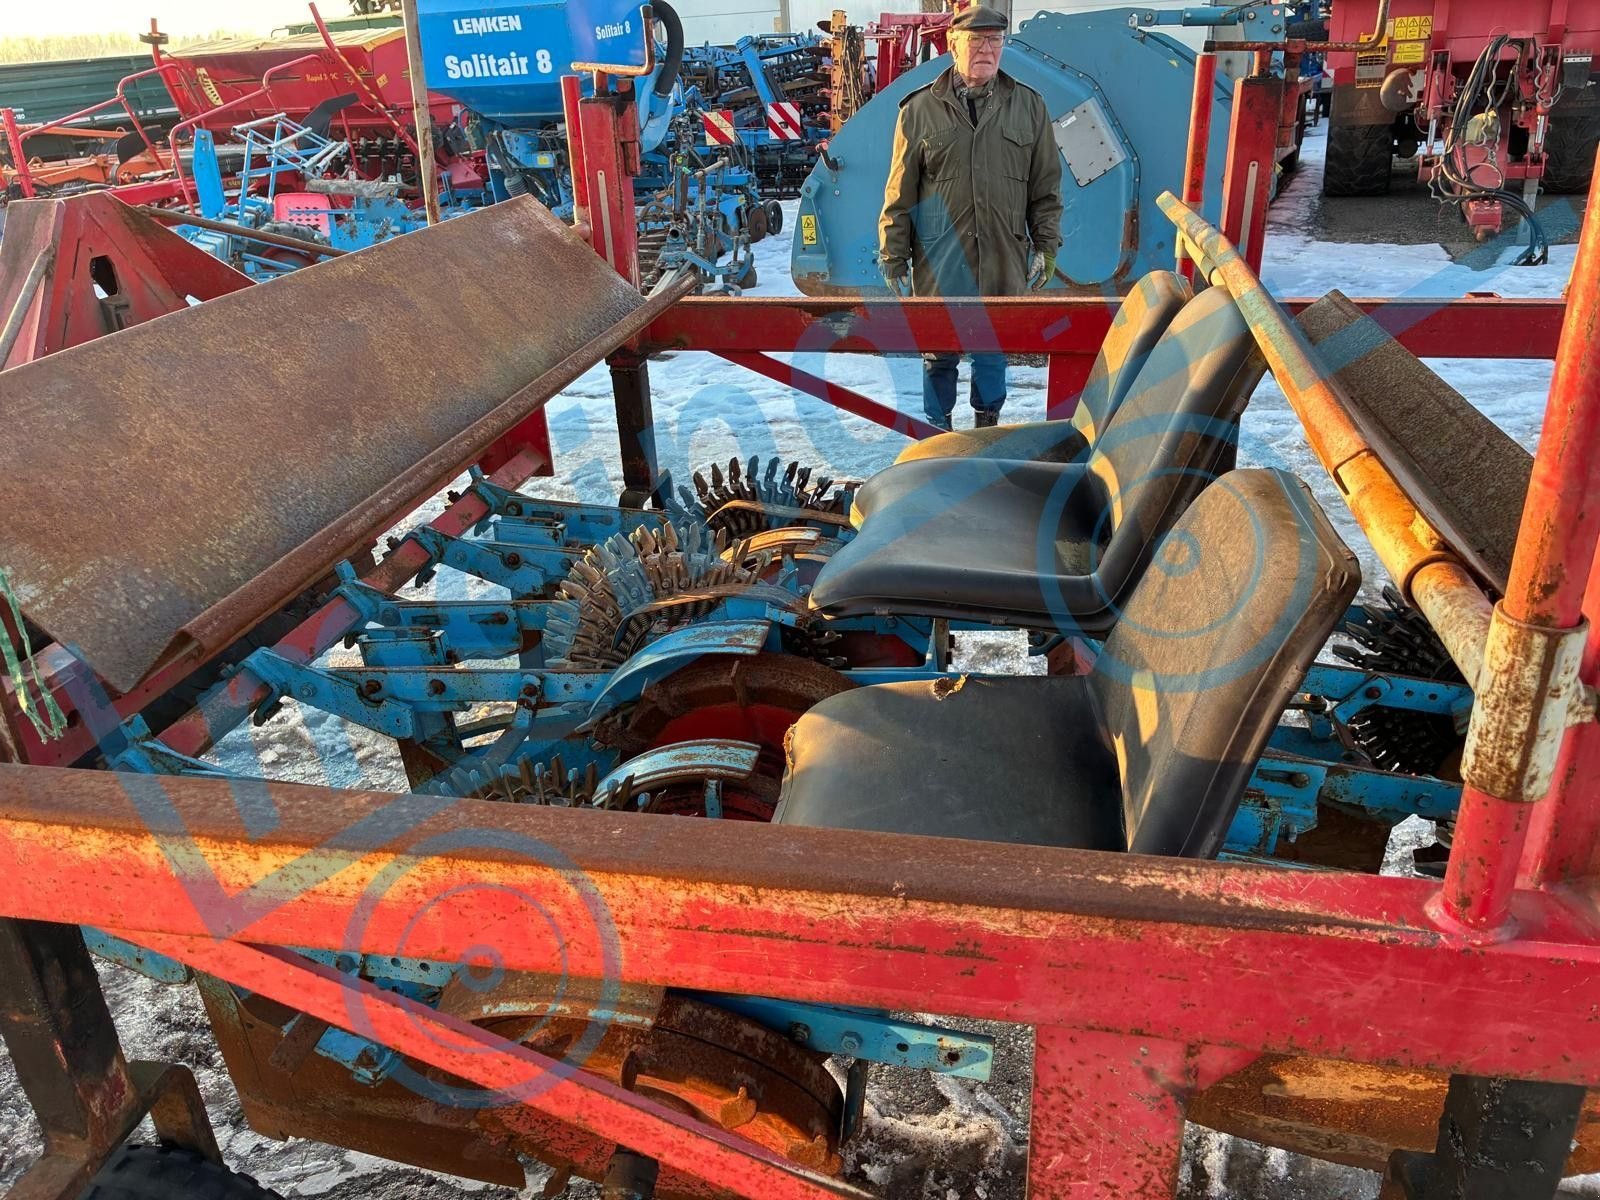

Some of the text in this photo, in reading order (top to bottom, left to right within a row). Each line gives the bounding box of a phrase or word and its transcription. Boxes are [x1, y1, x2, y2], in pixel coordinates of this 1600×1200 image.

[452, 15, 523, 37] LEMKEN
[595, 20, 632, 40] Solitair 8
[444, 49, 553, 79] Solitair 8
